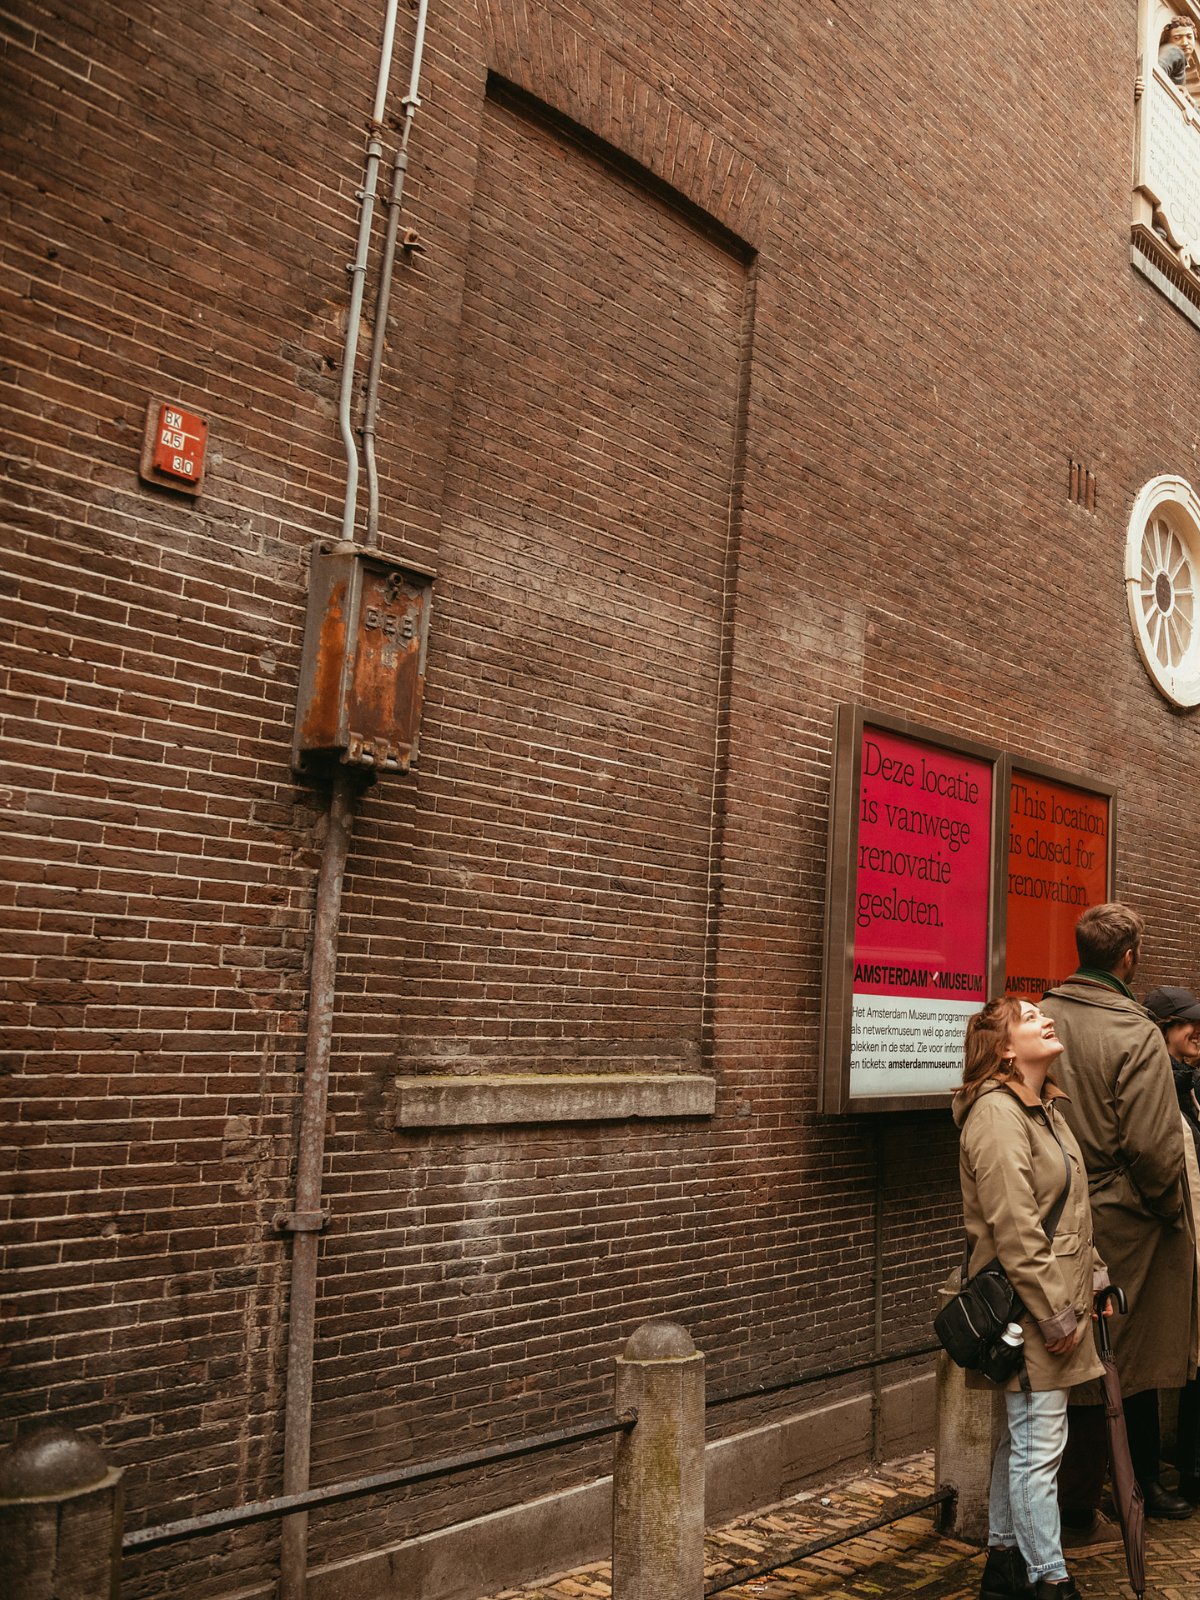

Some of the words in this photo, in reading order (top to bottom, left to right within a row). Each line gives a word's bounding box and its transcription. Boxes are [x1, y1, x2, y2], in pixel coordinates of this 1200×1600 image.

[165, 410, 181, 428] BK
[864, 741, 915, 787] Deze
[919, 758, 979, 804] locatie
[861, 788, 878, 824] is
[885, 804, 971, 853] vanwege
[1011, 783, 1047, 821] This
[1050, 795, 1105, 837] location
[1008, 824, 1022, 855] is
[1026, 830, 1072, 866] closed
[1075, 839, 1095, 870] for
[858, 845, 951, 884] renovatie
[1007, 875, 1090, 907] renovation.
[857, 887, 944, 928] gesloten.
[853, 963, 928, 988] AMSTERDAM
[938, 971, 983, 992] MUSEUM
[866, 1006, 908, 1019] Amsterdam
[908, 1009, 937, 1020] Museum
[850, 1023, 862, 1035] als
[862, 1024, 921, 1037] netwerkmuseum
[934, 1028, 944, 1039] op
[880, 1041, 887, 1052] in
[888, 1042, 899, 1053] de
[899, 1042, 916, 1053] stad.
[916, 1041, 928, 1053] Zie
[928, 1044, 943, 1053] voor
[850, 1060, 860, 1069] en
[861, 1058, 887, 1069] tickets:
[887, 1058, 964, 1069] amsterdammuseum.nl
